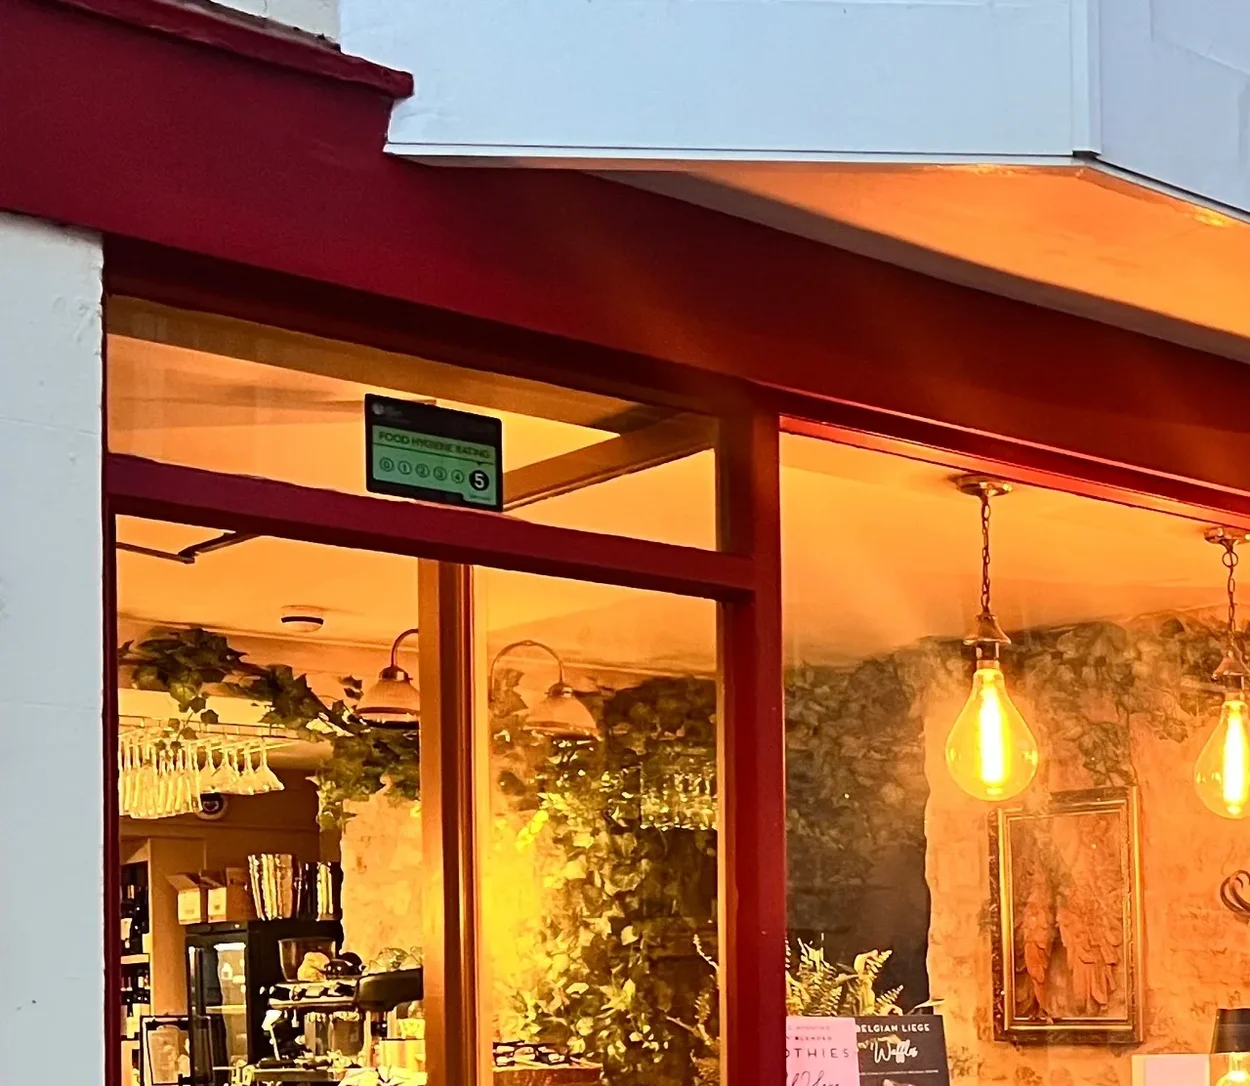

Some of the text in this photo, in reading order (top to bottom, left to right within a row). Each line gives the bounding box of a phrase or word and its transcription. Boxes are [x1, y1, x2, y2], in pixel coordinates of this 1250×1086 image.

[378, 431, 491, 459] FOOD HYGIENE RATING
[474, 473, 485, 489] 5
[901, 1023, 930, 1032] LIEGE
[874, 1039, 918, 1063] Waffles
